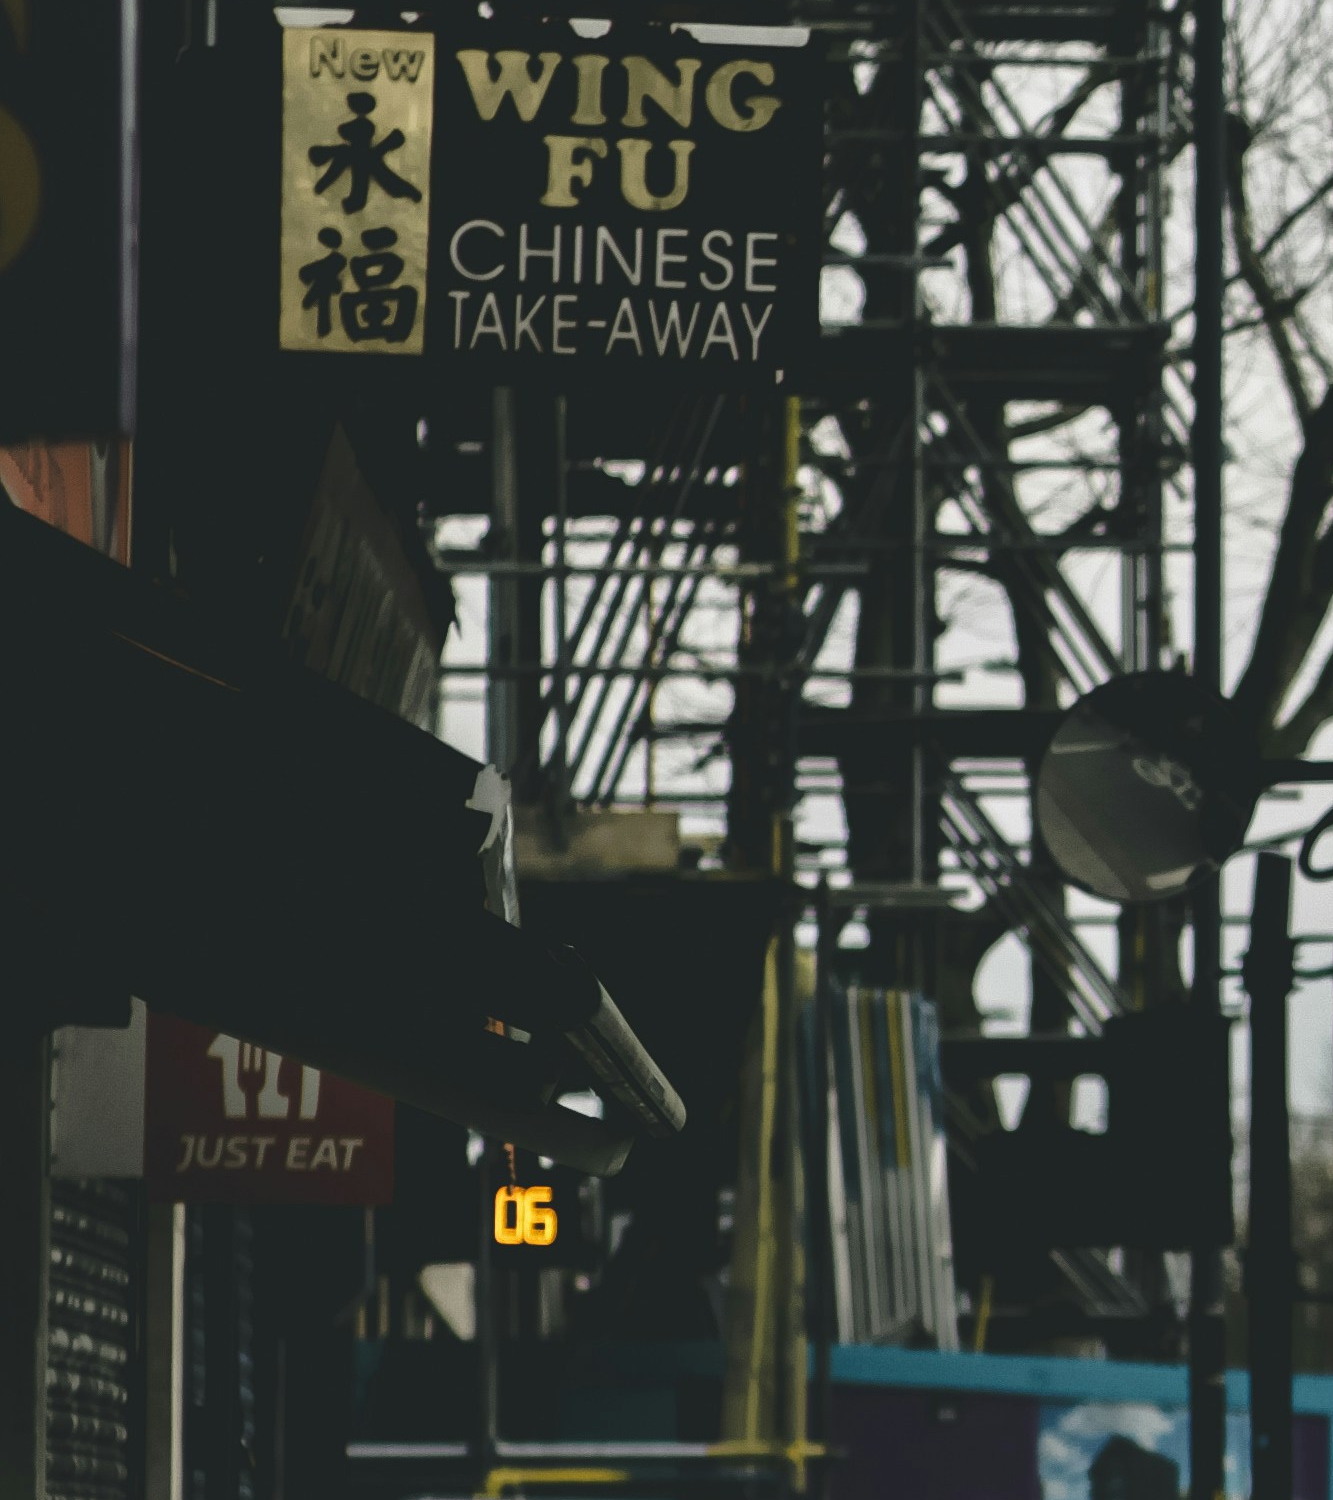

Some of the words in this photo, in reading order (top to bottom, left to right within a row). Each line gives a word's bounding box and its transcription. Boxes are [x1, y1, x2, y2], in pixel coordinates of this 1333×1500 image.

[309, 35, 426, 83] New
[456, 49, 782, 132] WING
[539, 134, 696, 211] FU
[298, 92, 423, 345] 永福
[448, 219, 779, 293] CHINESE
[448, 290, 773, 360] TAKE-AWAY
[177, 1134, 276, 1173] JUST
[284, 1137, 364, 1172] EAT
